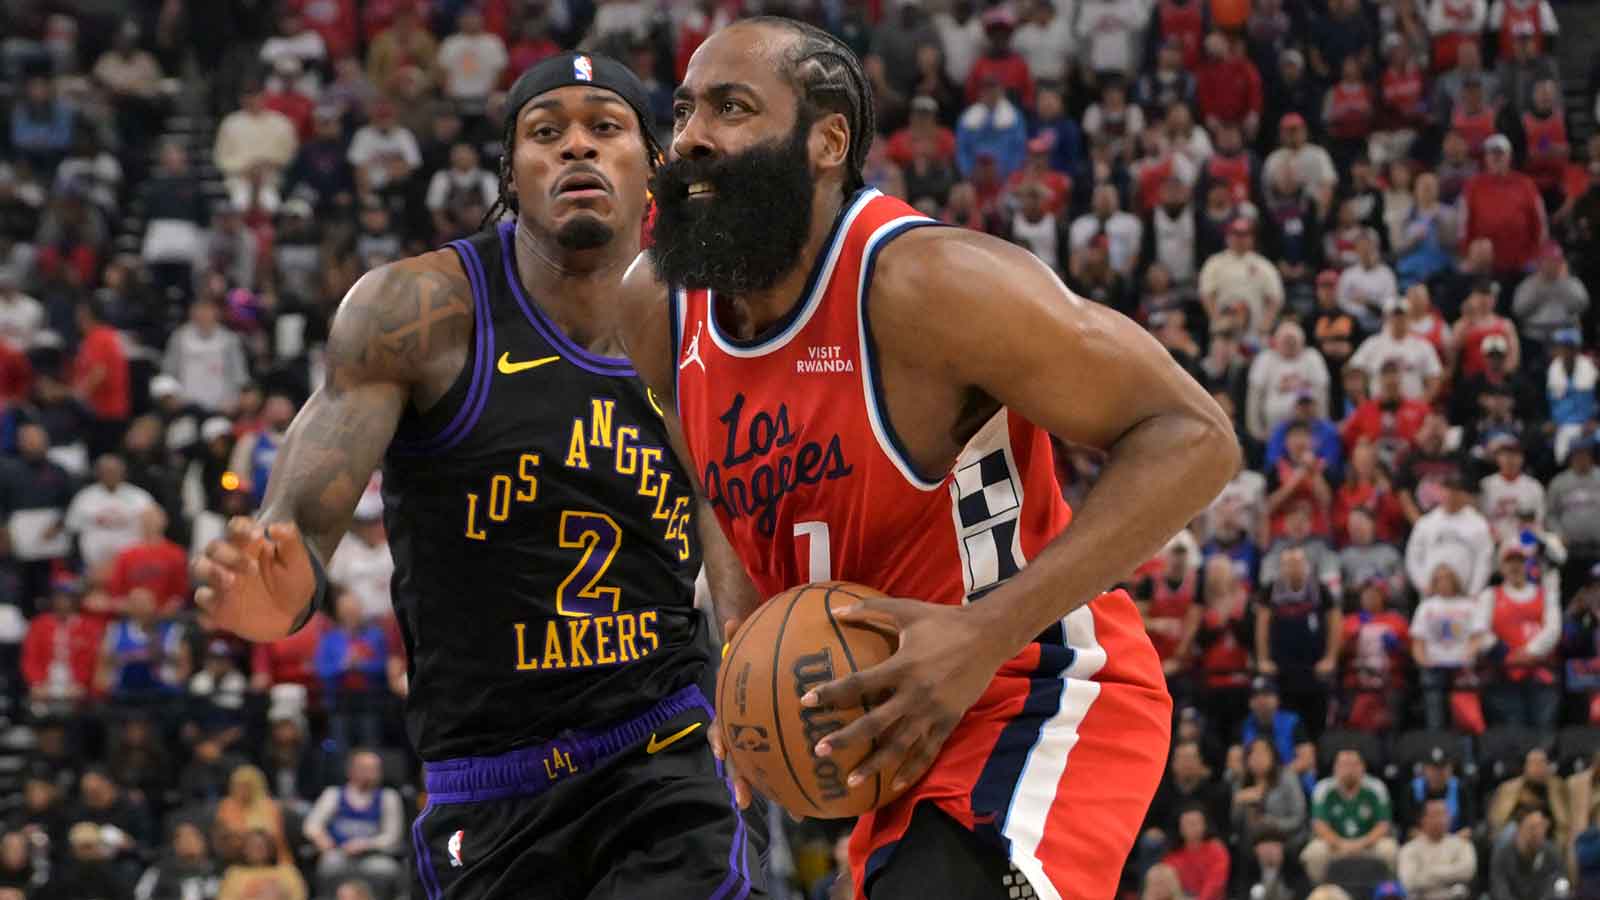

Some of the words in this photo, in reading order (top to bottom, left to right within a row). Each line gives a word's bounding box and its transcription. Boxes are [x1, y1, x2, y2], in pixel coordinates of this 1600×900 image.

[797, 360, 854, 373] RWANDA
[808, 346, 841, 359] VISIT
[720, 393, 795, 469] Los
[465, 454, 541, 541] LOS
[565, 398, 690, 562] ANGELES
[704, 432, 855, 538] Angees
[556, 510, 623, 617] 2
[793, 521, 831, 584] 1
[514, 610, 659, 670] LAKERS
[543, 747, 578, 779] LAL
